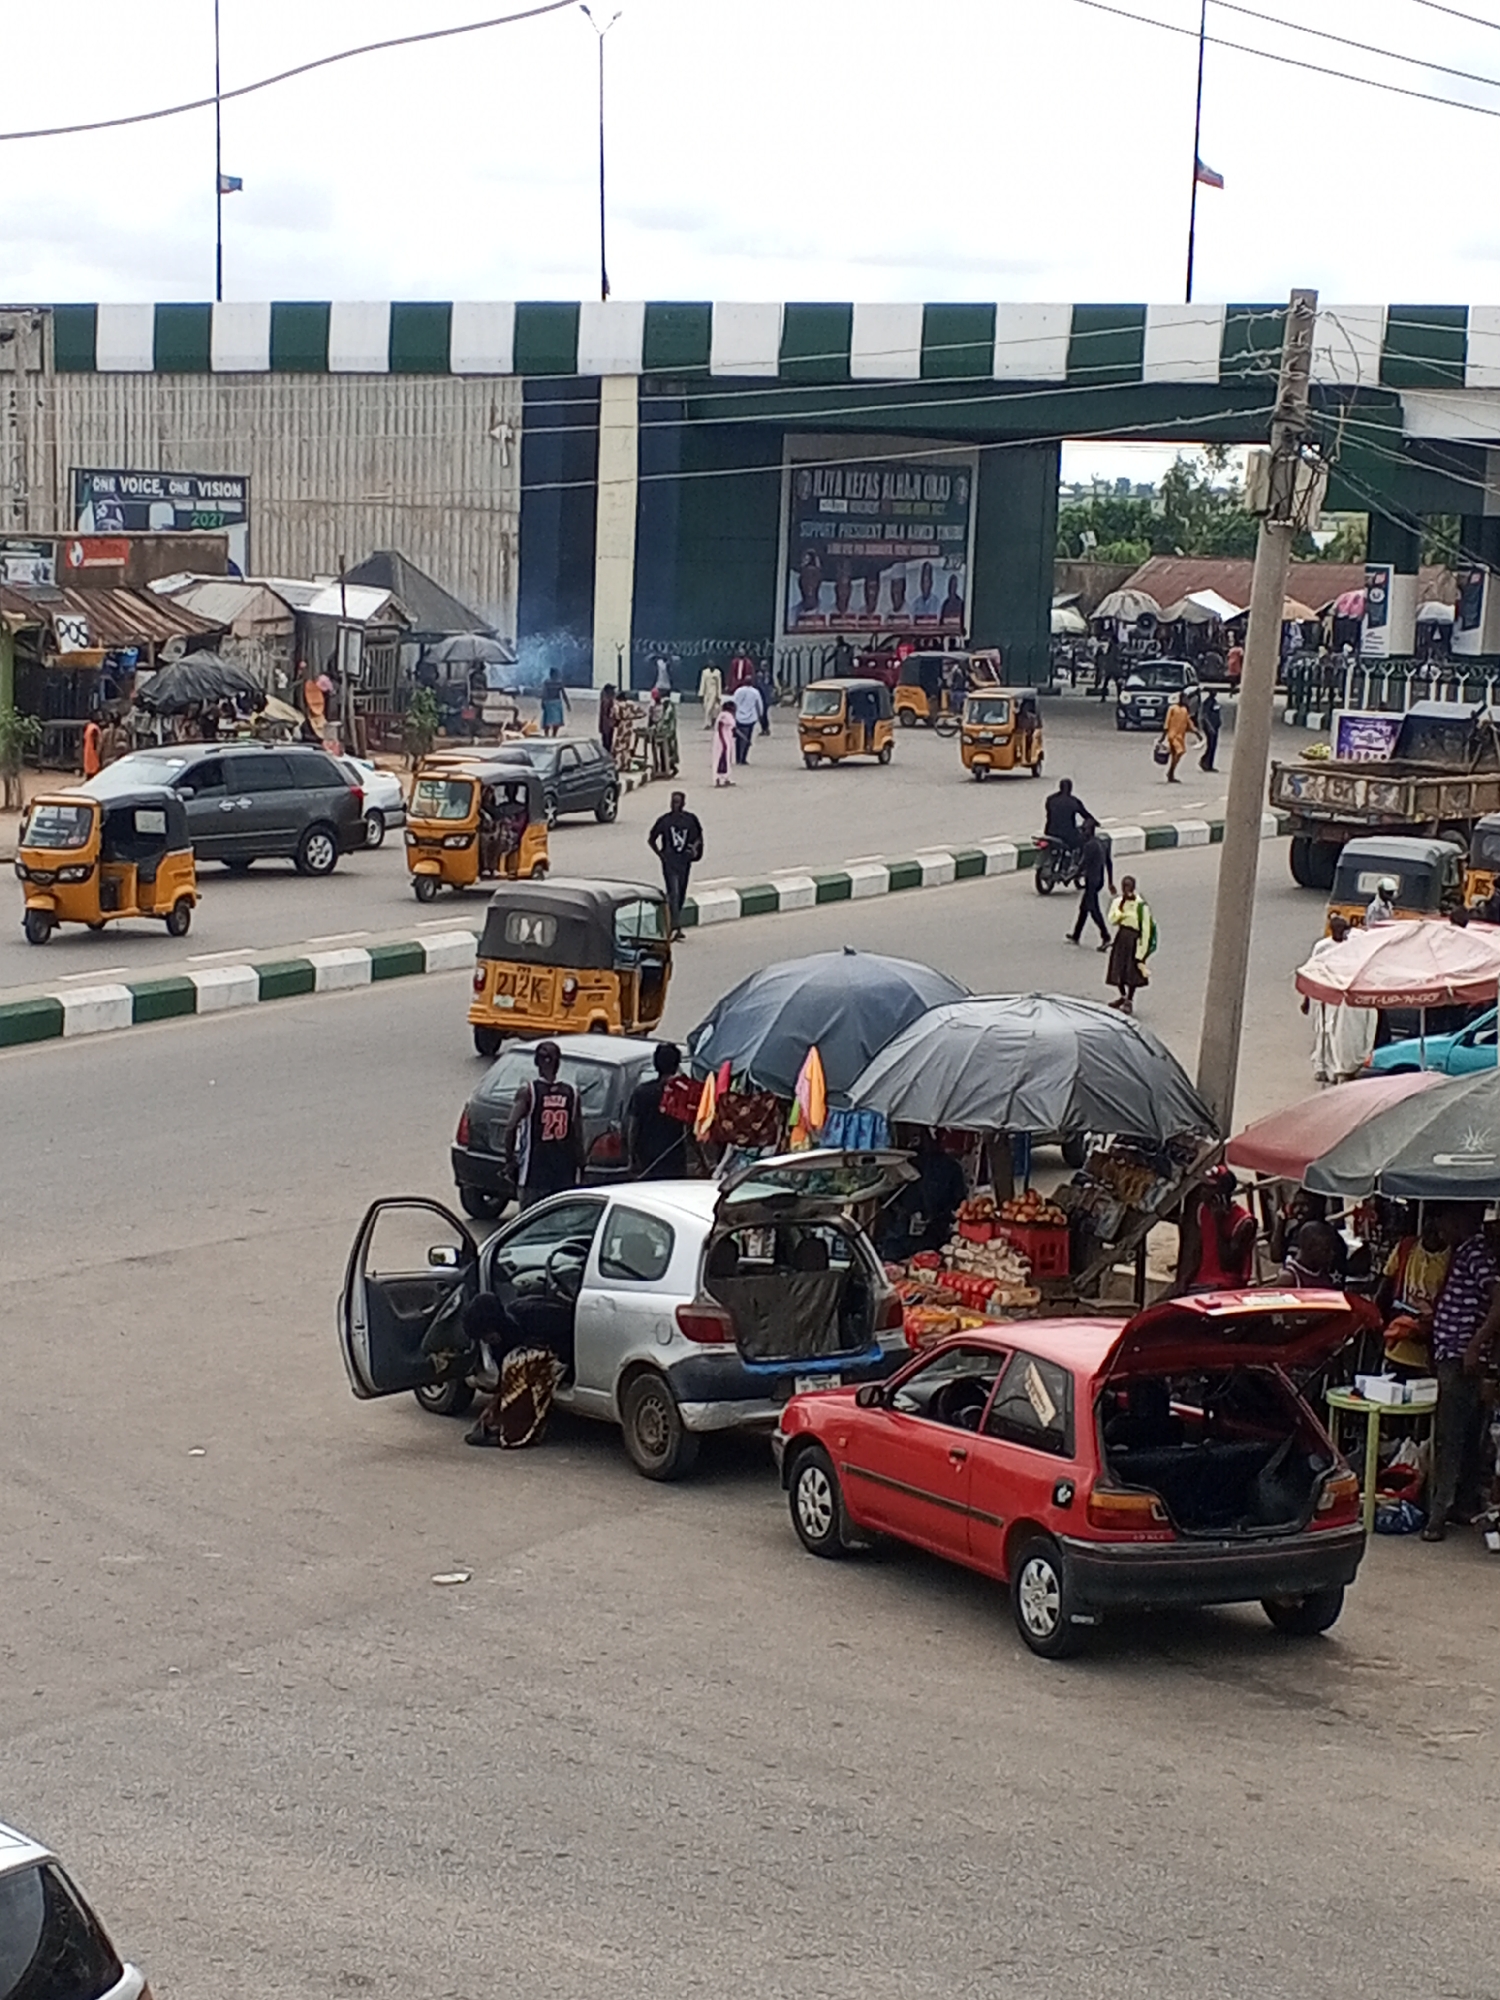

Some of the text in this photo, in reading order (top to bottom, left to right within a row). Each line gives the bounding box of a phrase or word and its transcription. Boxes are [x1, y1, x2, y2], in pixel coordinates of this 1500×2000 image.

[93, 476, 242, 498] ONE VOICE, ONE VISION
[190, 512, 225, 528] 2027
[56, 617, 89, 649] POS
[541, 1109, 568, 1140] 23
